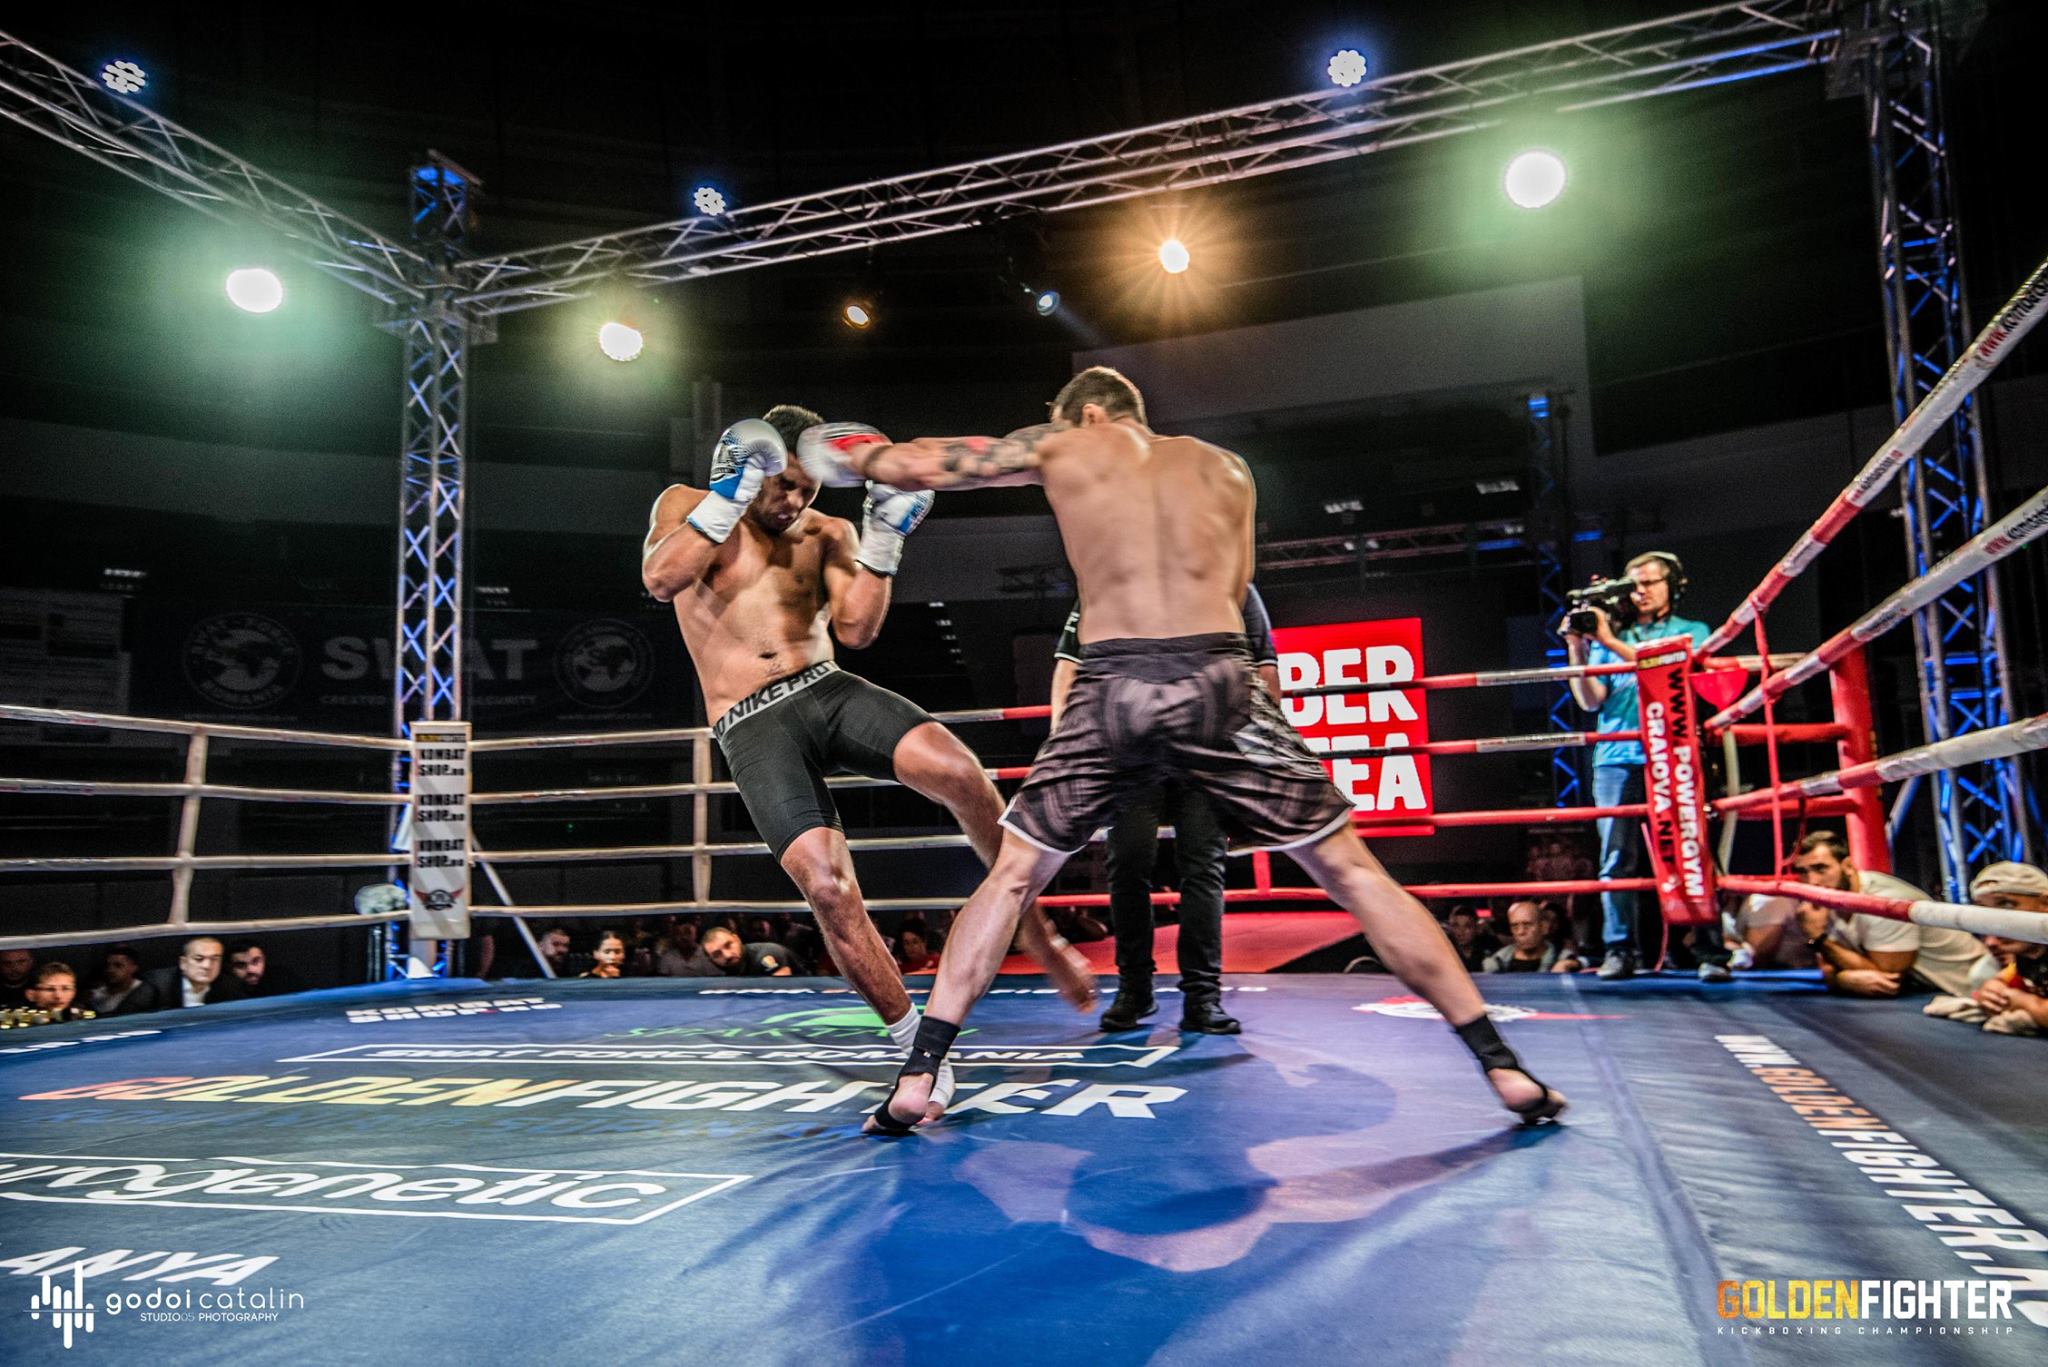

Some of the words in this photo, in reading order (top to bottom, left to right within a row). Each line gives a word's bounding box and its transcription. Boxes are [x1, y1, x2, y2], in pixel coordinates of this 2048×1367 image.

[728, 683, 785, 725] NIKE
[420, 749, 465, 760] KOMBAT
[420, 794, 465, 805] KOMBAT
[420, 839, 465, 850] KOMBAT
[756, 1050, 1085, 1060] ROMNIA
